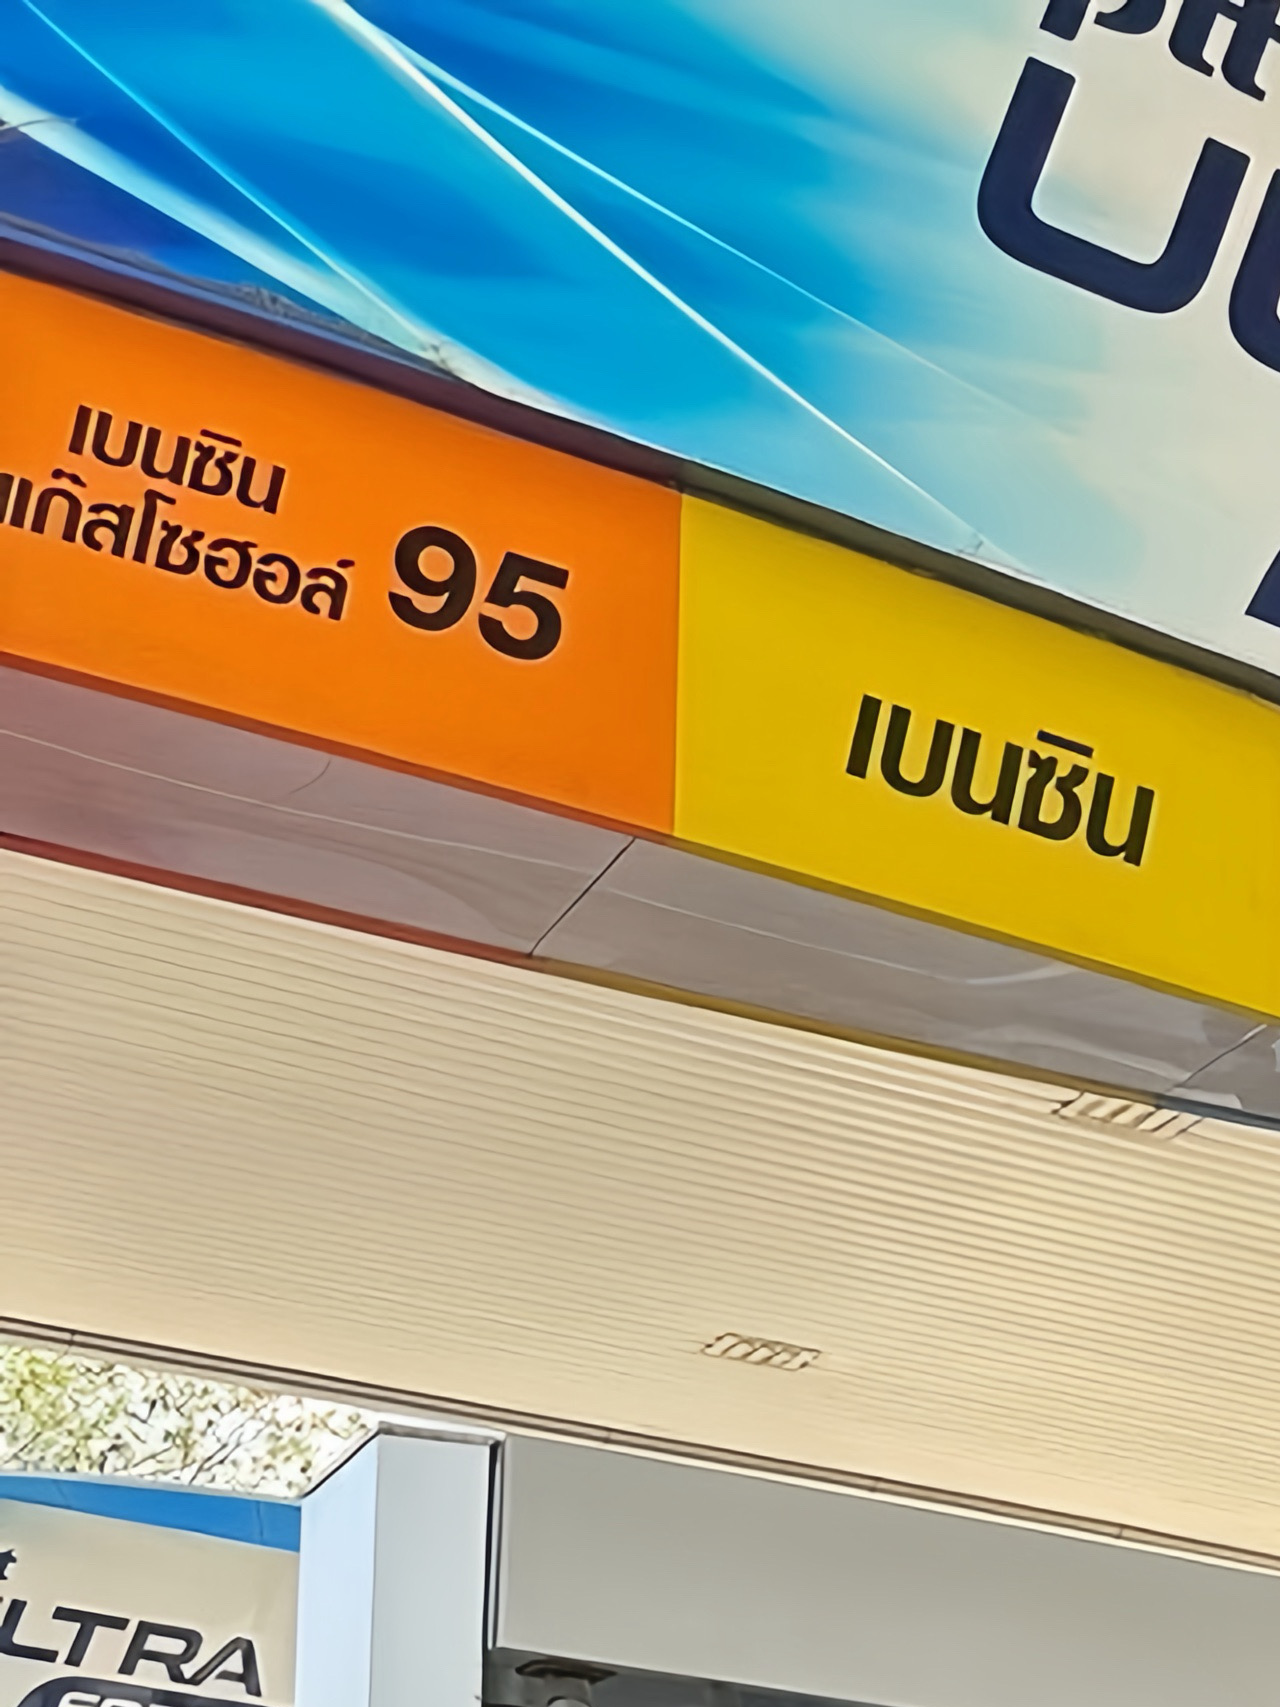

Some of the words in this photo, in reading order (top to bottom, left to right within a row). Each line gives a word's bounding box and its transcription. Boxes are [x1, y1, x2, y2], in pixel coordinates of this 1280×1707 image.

[67, 403, 287, 516] เบนซิน
[0, 467, 356, 622] แก๊สโซฮอล์
[386, 525, 570, 661] 95
[843, 693, 1156, 867] เบนซิน
[0, 1596, 262, 1697] LTRA
